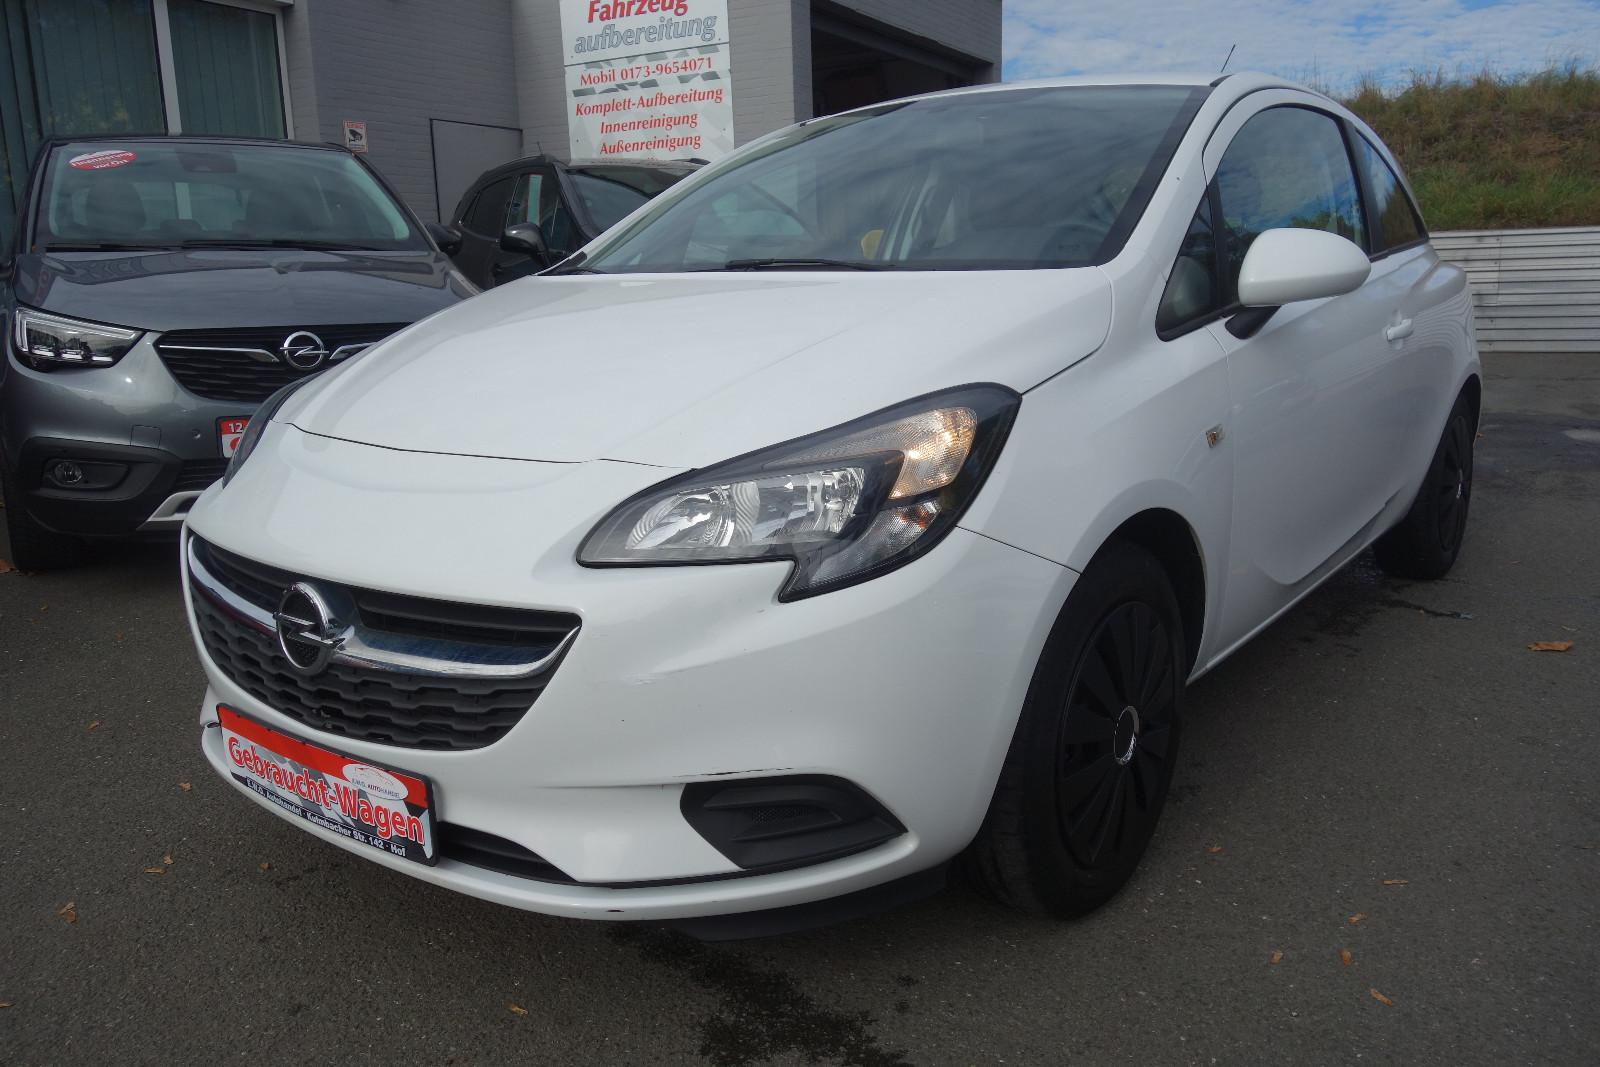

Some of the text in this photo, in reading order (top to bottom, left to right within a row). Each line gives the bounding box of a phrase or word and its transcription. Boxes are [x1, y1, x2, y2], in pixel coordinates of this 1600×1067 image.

[587, 0, 688, 23] Fahrzeug
[574, 15, 718, 53] aufbereitung
[580, 57, 713, 86] Mobil 0173-9654071
[575, 87, 723, 117] Komplett-Aufbereitung
[600, 113, 698, 134] Innenreinigung
[600, 135, 701, 154] Außenreinigung
[227, 736, 425, 845] Gebraucht-Wagen
[306, 811, 351, 837] Kulmbacher
[352, 830, 368, 843] Str.
[368, 836, 384, 850] 142
[390, 843, 406, 857] Hof
